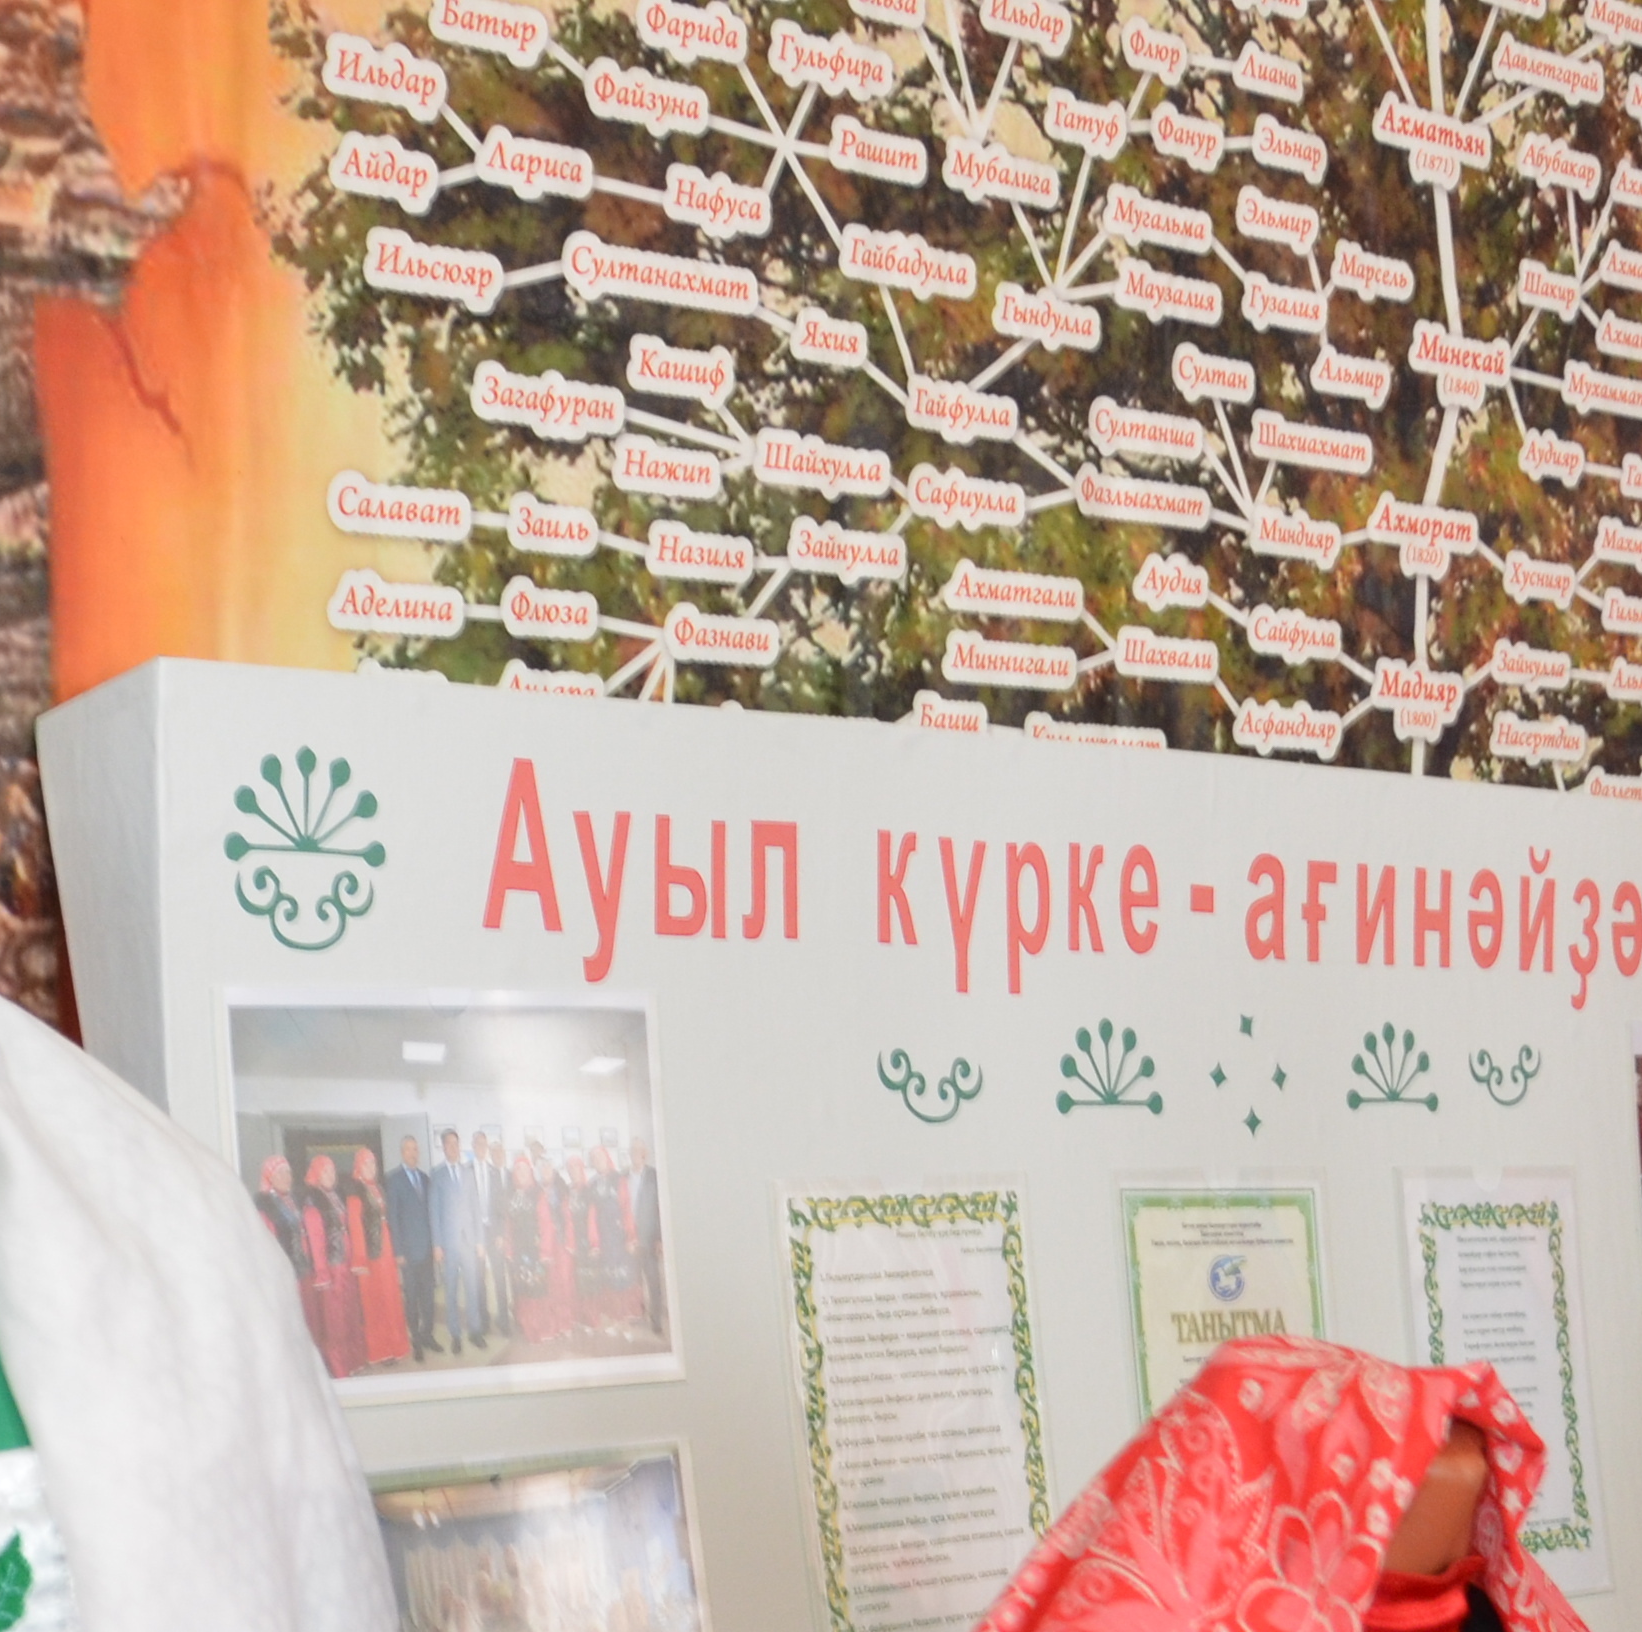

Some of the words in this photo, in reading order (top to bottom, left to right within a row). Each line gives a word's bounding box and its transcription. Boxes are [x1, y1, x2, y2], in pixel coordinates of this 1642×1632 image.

[441, 0, 537, 50] Батыр
[645, 4, 739, 49] Фарида
[857, 0, 917, 15] льза
[990, 0, 1064, 43] Ильдар
[779, 34, 884, 82] Гульфира
[1130, 35, 1181, 71] Флюр
[1242, 50, 1298, 90] Лиана
[1498, 41, 1599, 92] Давлетгарай
[336, 47, 437, 105] Ильдар
[593, 72, 700, 121] Файзуна
[1054, 100, 1119, 145] Гатуф
[1157, 115, 1219, 157] Фанур
[1380, 101, 1485, 156] Ахматьян
[487, 141, 582, 185] Лариса
[839, 129, 918, 171] Рашит
[1261, 127, 1322, 169] Эльнар
[1416, 148, 1455, 177] (1871)
[1523, 143, 1596, 187] Абубакар
[342, 147, 429, 198] Айдар
[951, 150, 1051, 195] Мубалига
[674, 178, 762, 224] Нафуса
[1113, 197, 1205, 239] Мугальма
[1244, 199, 1313, 240] Эльмир
[375, 241, 494, 297] Ильсюяр
[571, 246, 749, 301] Султанахмат
[850, 238, 969, 287] Гайбадулла
[1339, 251, 1408, 288] Марсель
[1125, 271, 1215, 312] Маузалия
[1250, 284, 1321, 320] Гузалия
[1523, 270, 1576, 307] Шакир
[1002, 295, 1093, 336] Гындулла
[800, 320, 859, 354] Яхия
[1416, 332, 1505, 375] Минекай
[638, 348, 725, 393] Кашиф
[1178, 355, 1248, 389] Султан
[1318, 357, 1384, 396] Альмир
[1442, 373, 1480, 398] (1840)
[482, 375, 615, 425] Загафуран
[915, 388, 1010, 428] Гайфулла
[1094, 409, 1196, 447] Султанша
[1258, 422, 1366, 461] Шахиахмат
[624, 448, 711, 485] Нажип
[764, 441, 882, 486] Шайхулла
[1526, 440, 1580, 474] Аудияр
[337, 484, 461, 528] Салават
[915, 477, 1017, 517] Сафиулла
[1081, 476, 1203, 515] Фазлыахмат
[517, 506, 589, 542] Заиль
[1259, 517, 1335, 555] Миндияр
[1376, 505, 1472, 546] Ахморат
[658, 534, 745, 569] Назиля
[797, 531, 899, 571] Зайнулла
[1405, 543, 1444, 568] (1820)
[956, 575, 1077, 608] Ахматгали
[1140, 567, 1202, 599] Аудия
[1510, 562, 1571, 596] Хуснияр
[339, 584, 453, 623] Аделина
[510, 591, 589, 626] Флюза
[674, 616, 770, 652] Фазнави
[1254, 617, 1336, 650] Сайфулла
[952, 644, 1069, 677] Миннигали
[1124, 639, 1212, 669] Шахвали
[1498, 650, 1566, 679] Зайнулла
[1378, 670, 1458, 709] Мадияр
[1240, 711, 1337, 745] Асфандияр
[1399, 709, 1438, 731] (1800)
[1497, 721, 1580, 754] Насертдин
[483, 757, 801, 983] Ауыл
[1171, 1309, 1287, 1344] ТАНЫТМА
